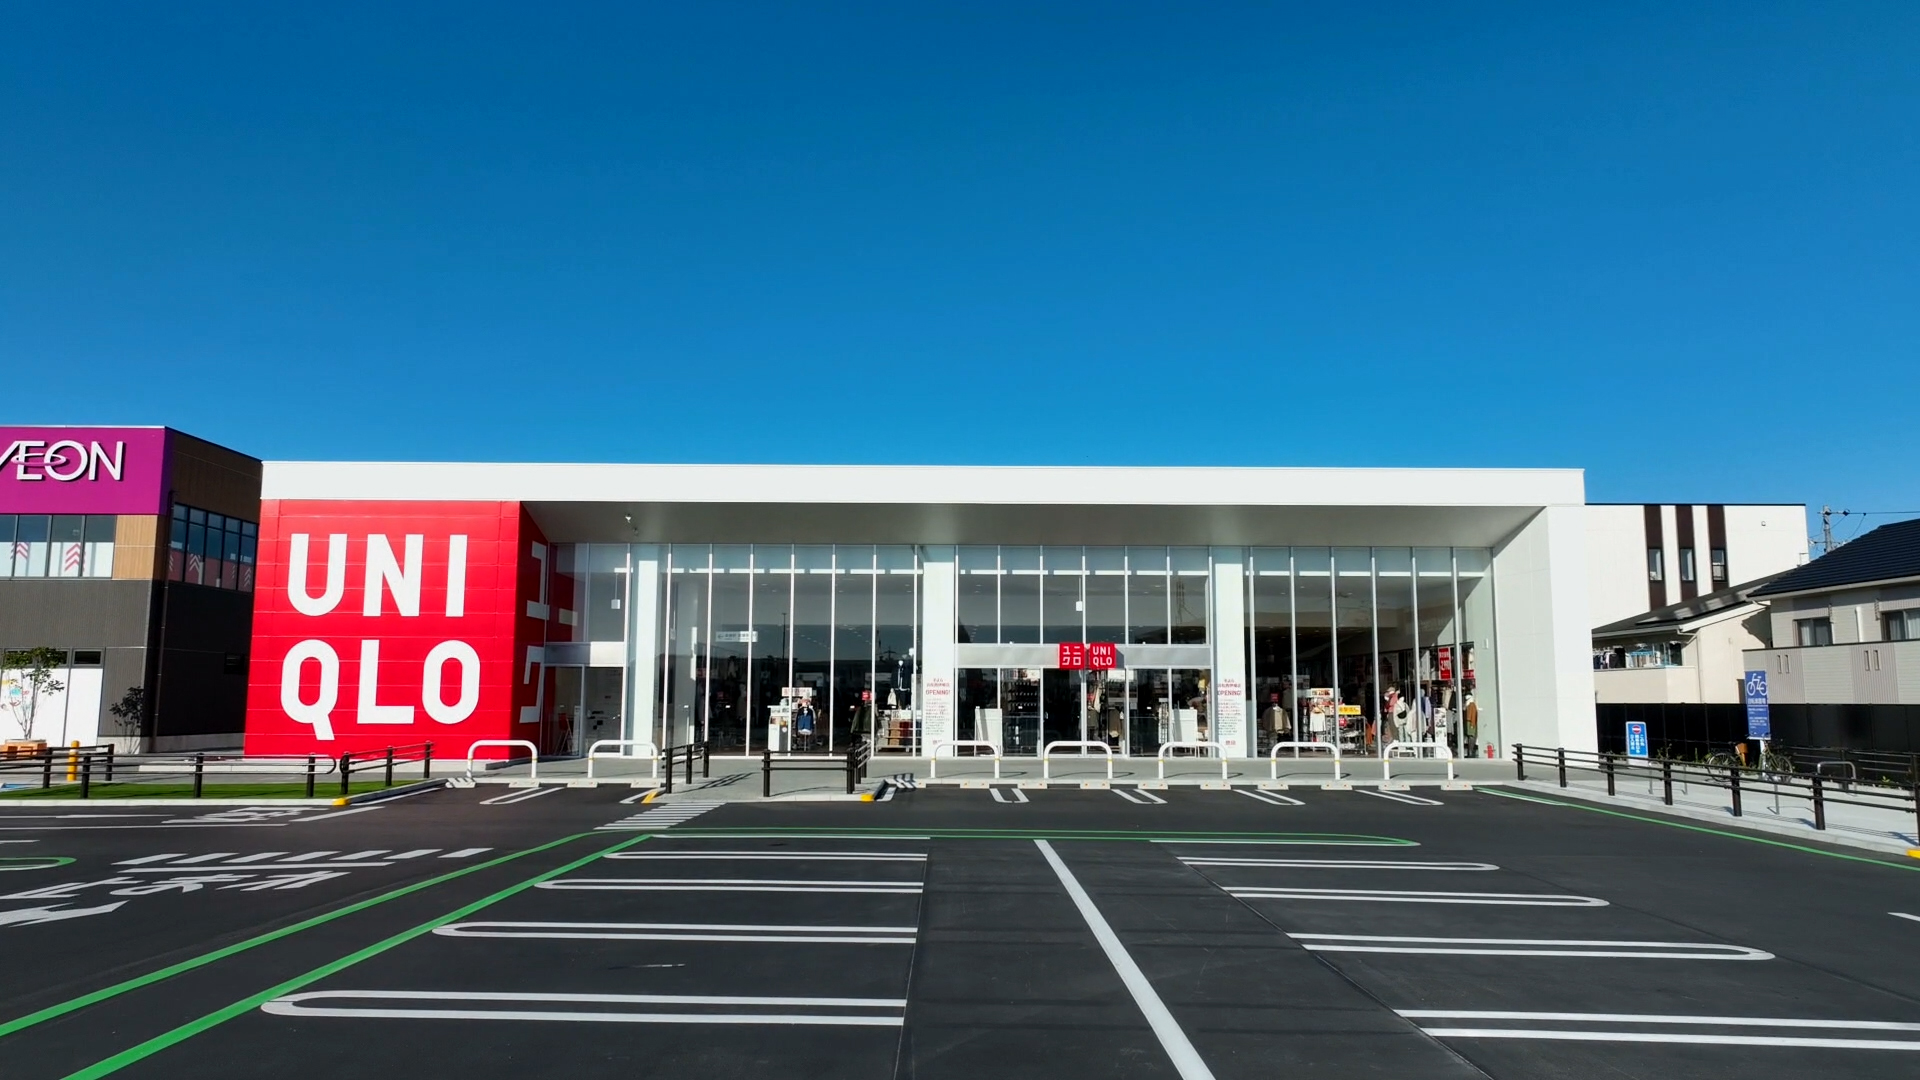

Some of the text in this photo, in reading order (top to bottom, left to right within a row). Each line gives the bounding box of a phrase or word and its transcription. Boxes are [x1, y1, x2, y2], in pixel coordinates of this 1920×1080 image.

[287, 533, 468, 617] UNI
[1062, 645, 1081, 655] ユニ
[1092, 646, 1111, 655] UNI
[1062, 656, 1081, 666] クロ
[1092, 656, 1113, 667] QLO
[280, 639, 481, 741] QLO
[0, 870, 351, 900] 止まれ
